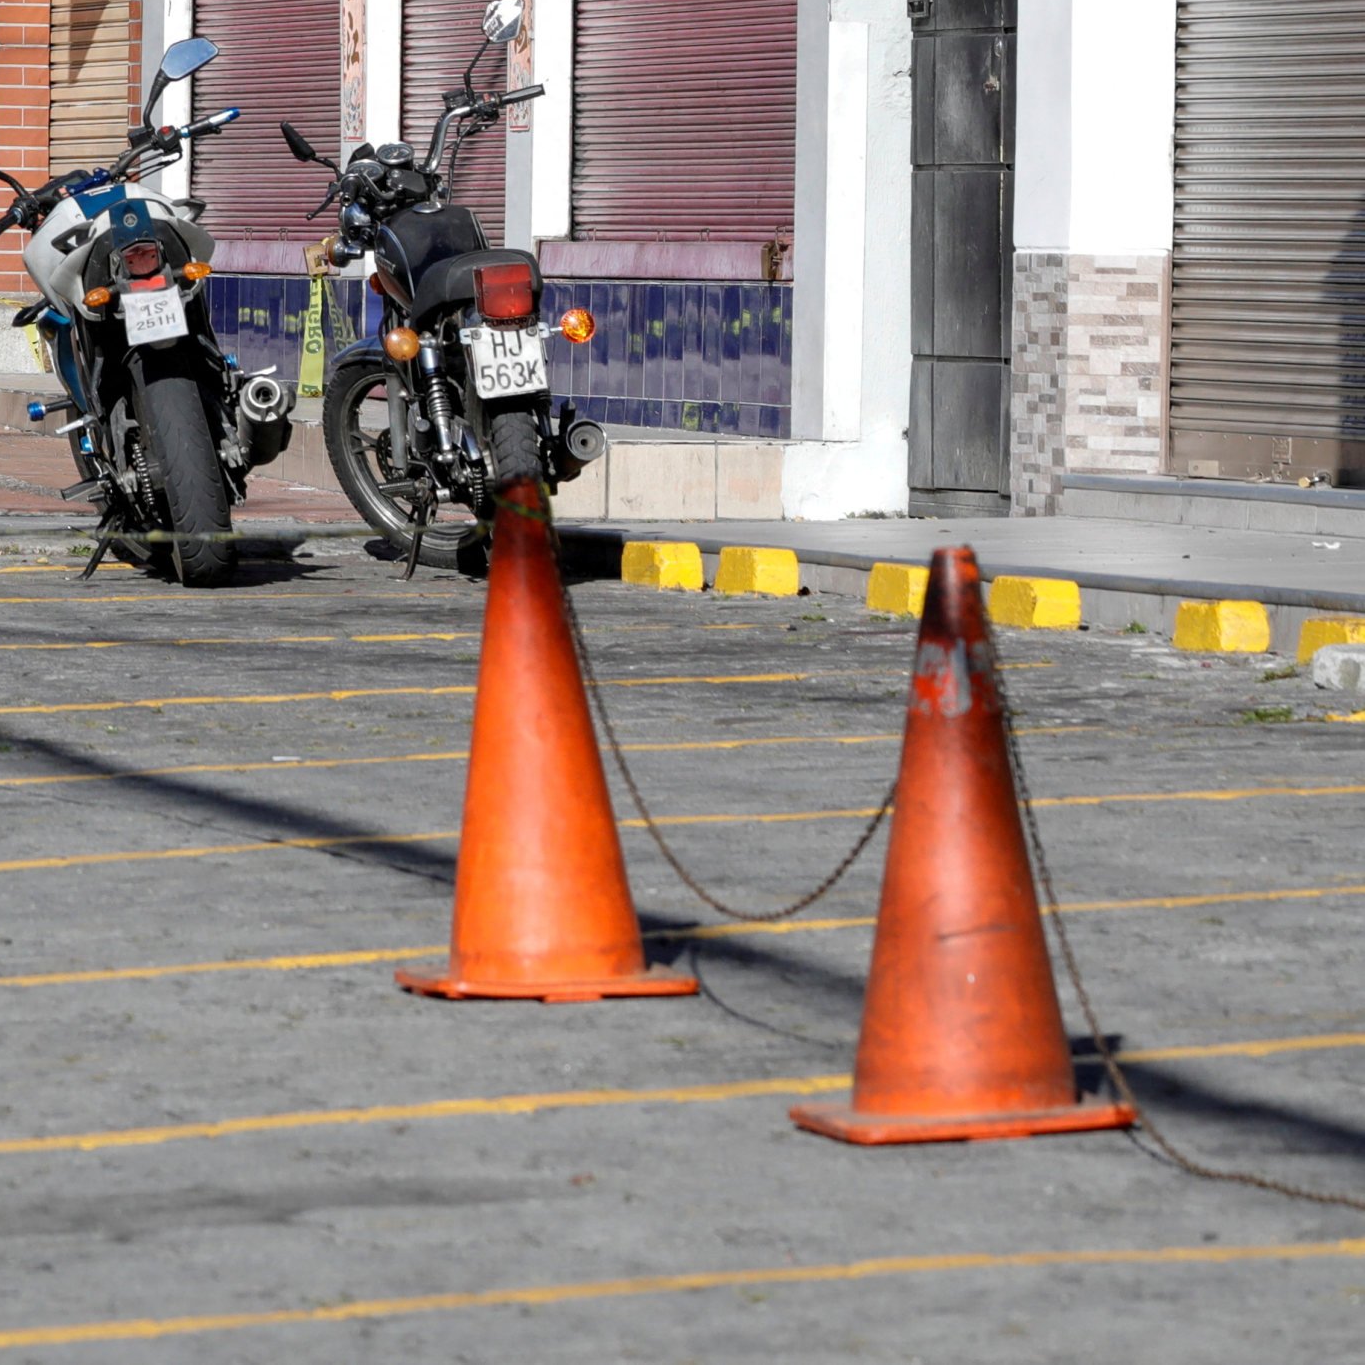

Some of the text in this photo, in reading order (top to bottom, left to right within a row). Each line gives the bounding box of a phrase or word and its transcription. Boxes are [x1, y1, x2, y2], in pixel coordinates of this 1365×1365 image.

[136, 313, 176, 331] 251H
[490, 330, 522, 358] HJ
[481, 359, 543, 391] 563K
